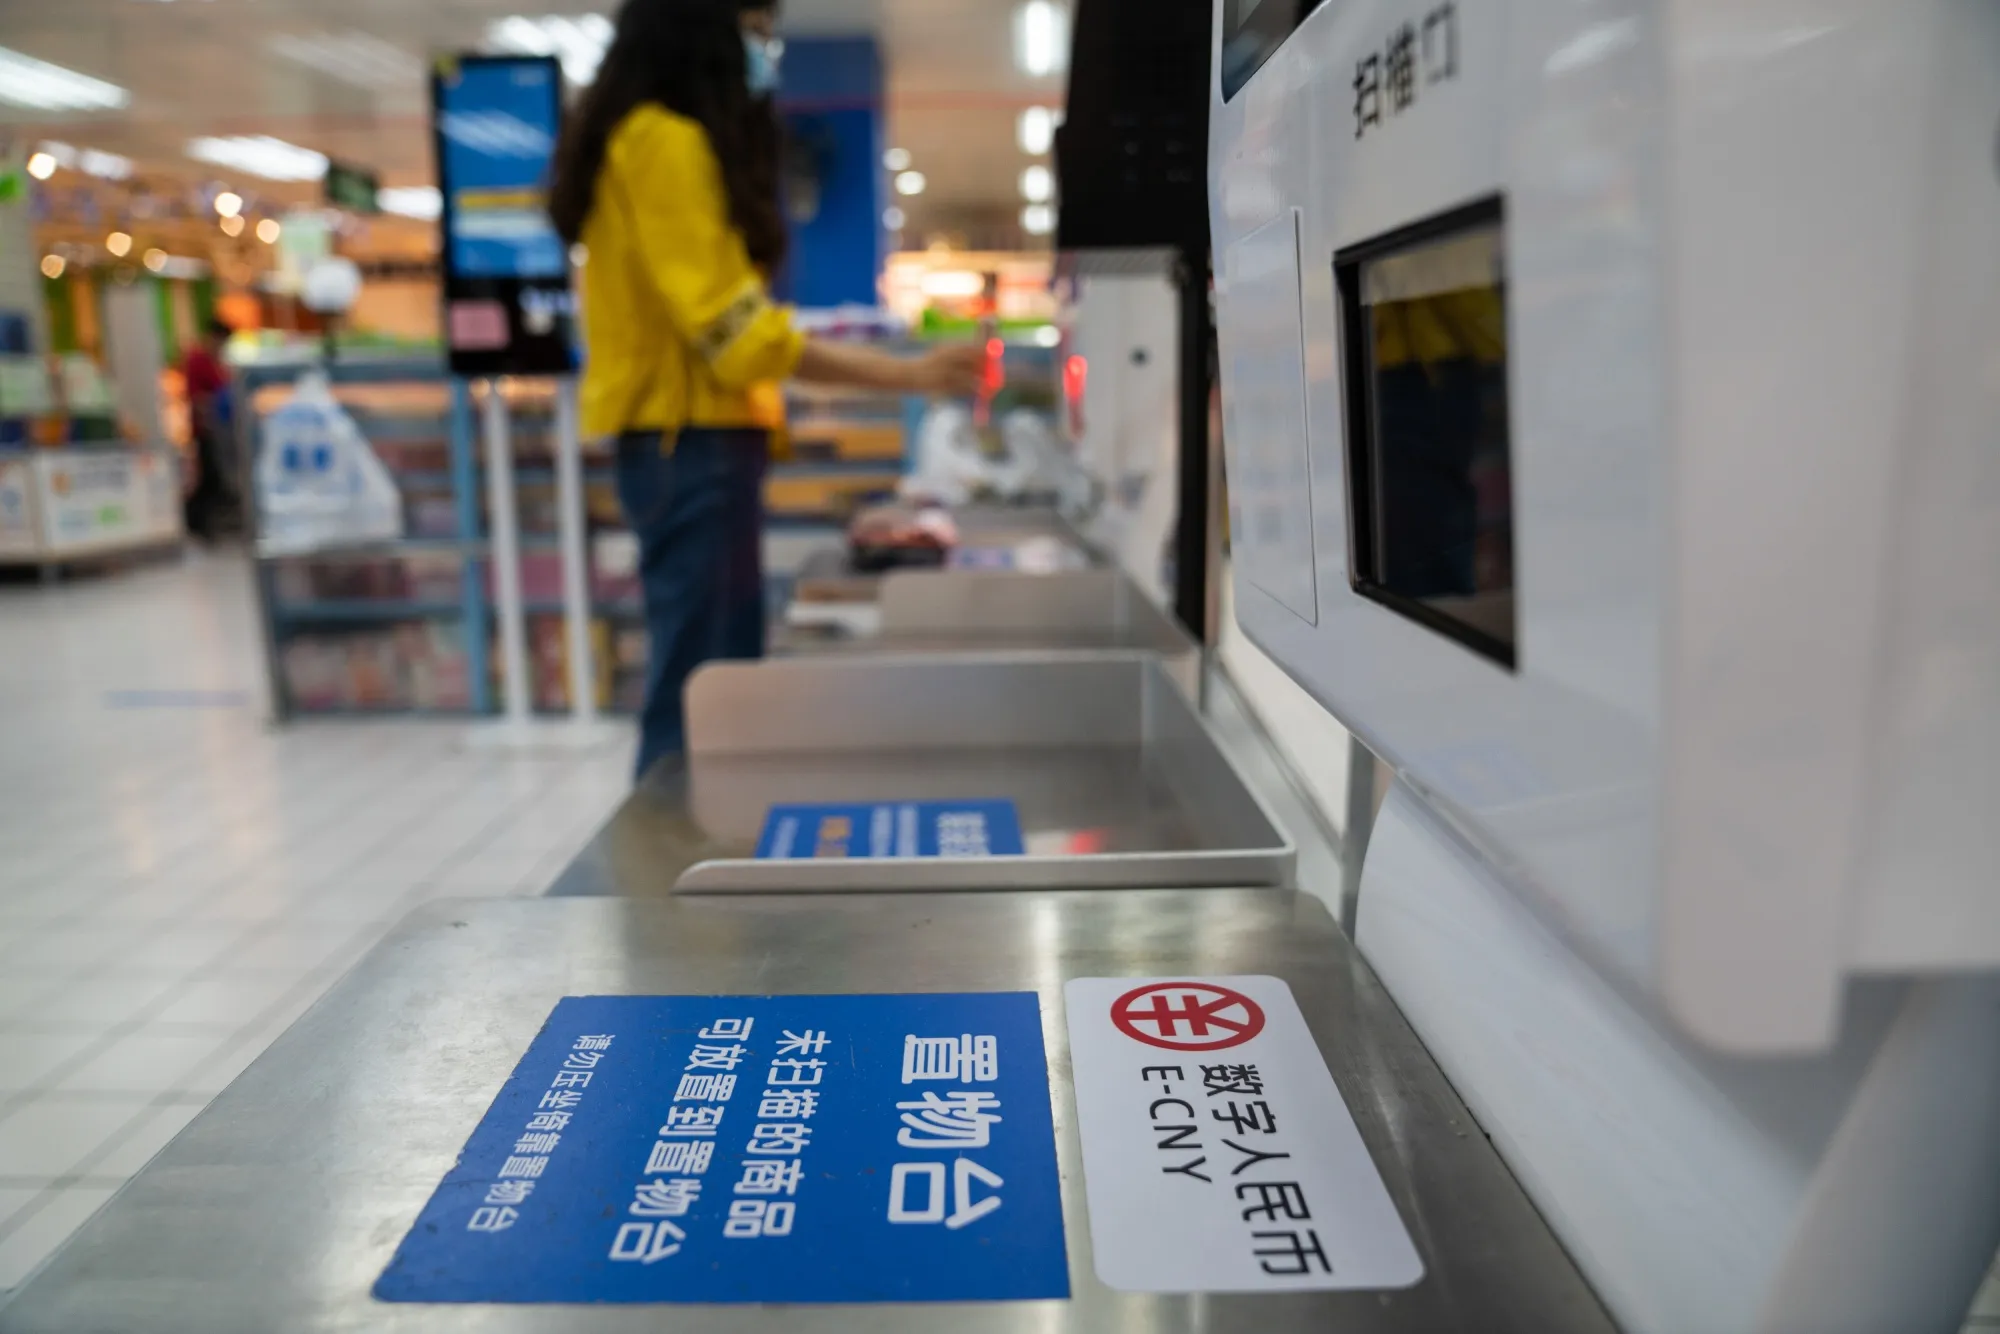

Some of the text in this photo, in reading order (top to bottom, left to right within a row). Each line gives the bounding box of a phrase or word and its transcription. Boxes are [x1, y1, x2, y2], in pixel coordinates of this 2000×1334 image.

[467, 1033, 616, 1233] 请勿压坐倚靠置物台
[609, 1016, 754, 1264] 可放置到置物台
[723, 1029, 831, 1238] 未扫描的商品
[888, 1033, 1003, 1229] 置物台
[1141, 1065, 1212, 1183] E-CNY
[1199, 1064, 1333, 1275] 数字人民币
